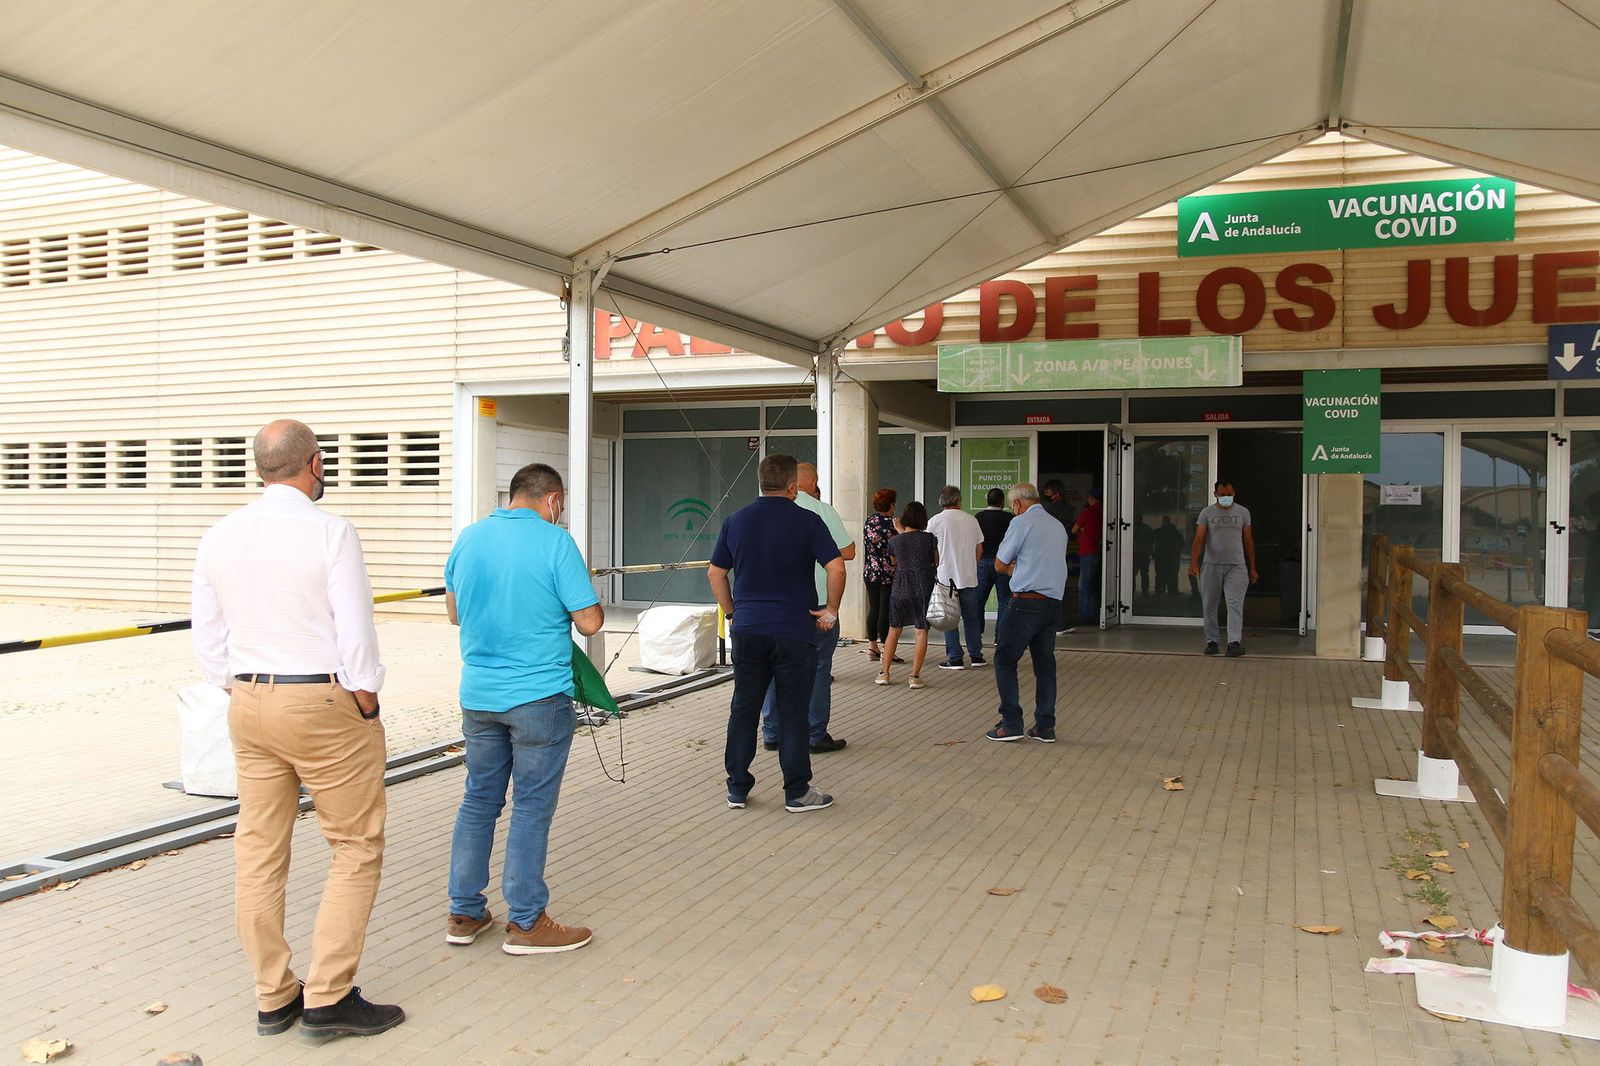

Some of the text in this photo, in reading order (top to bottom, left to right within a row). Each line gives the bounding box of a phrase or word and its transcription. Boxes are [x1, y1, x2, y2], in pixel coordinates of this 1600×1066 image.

[1328, 184, 1506, 218] VACUNACIÓN
[1224, 213, 1259, 224] Junta
[1224, 222, 1302, 238] de Andalucía
[1374, 216, 1457, 239] COVID
[979, 274, 1099, 343] DE
[1138, 263, 1337, 337] LOS
[1372, 250, 1600, 330] JUE
[1034, 360, 1077, 373] ZONA
[1112, 356, 1193, 371] PEATONES
[1305, 394, 1378, 407] VACUNACIÓN
[1026, 416, 1051, 424] ENTRADA
[1204, 413, 1230, 421] SALIDA
[1324, 409, 1359, 419] COVID
